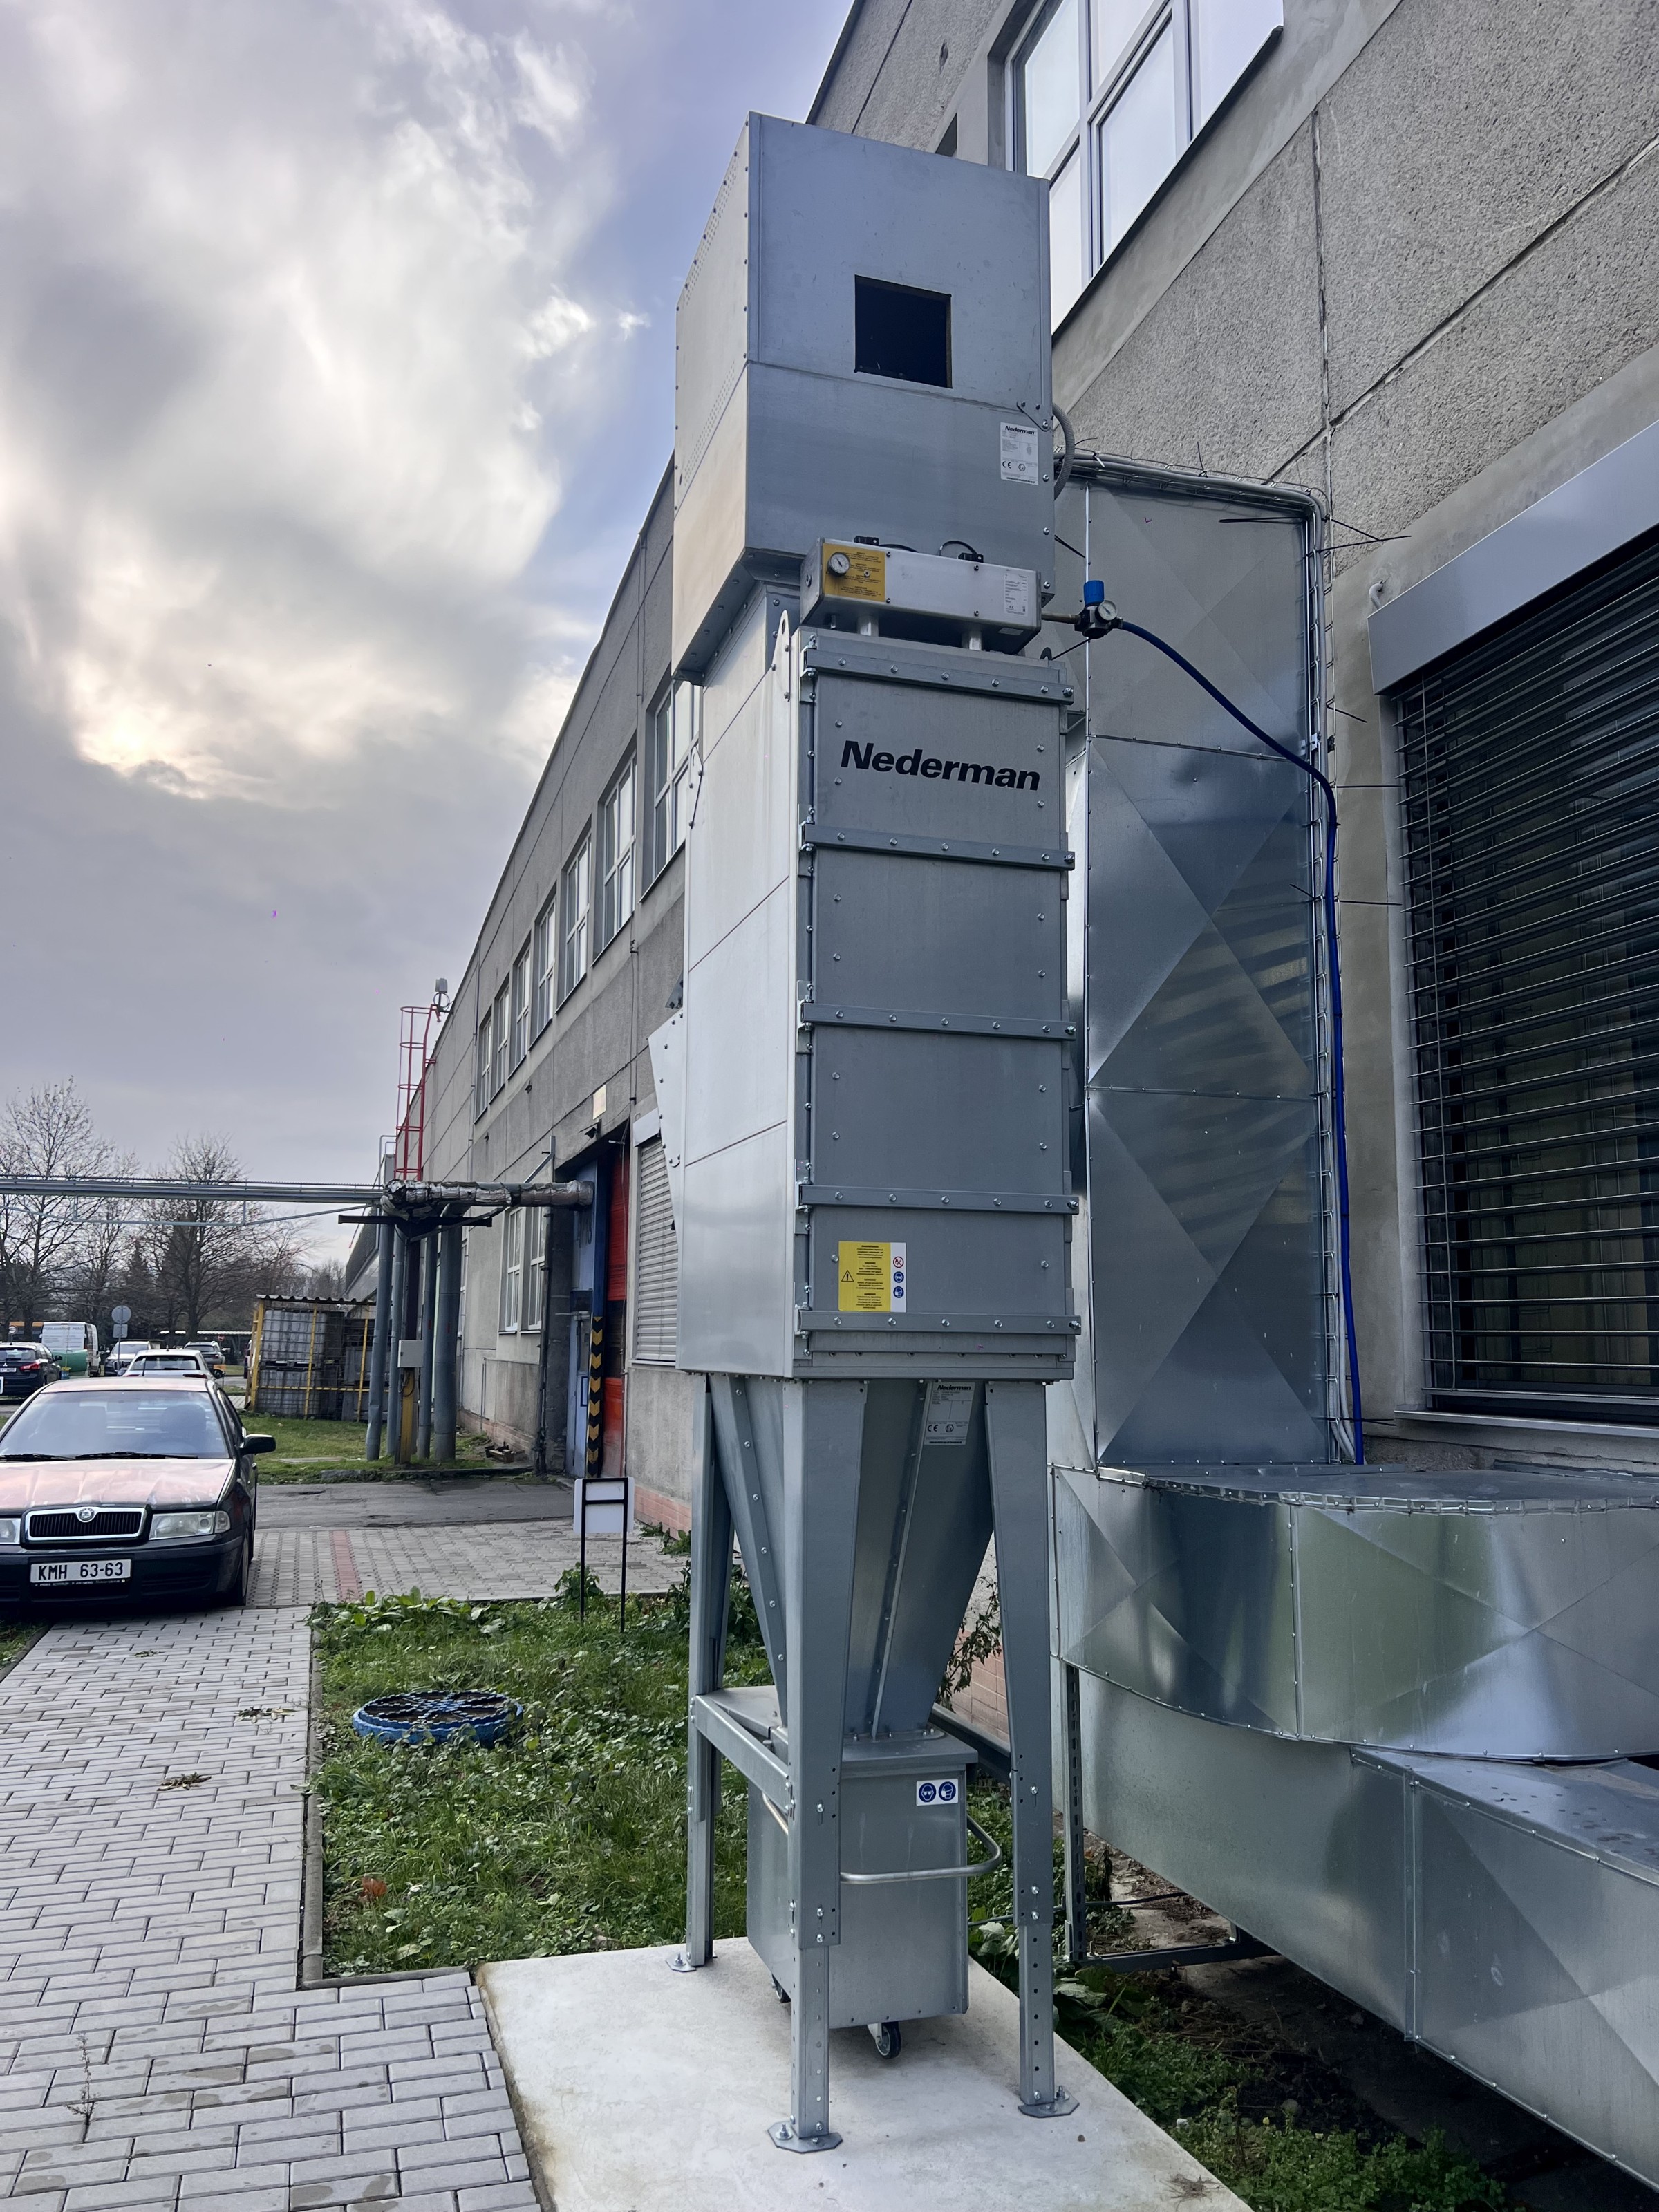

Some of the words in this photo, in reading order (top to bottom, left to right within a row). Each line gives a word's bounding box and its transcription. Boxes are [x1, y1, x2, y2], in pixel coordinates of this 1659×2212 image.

[1005, 425, 1035, 435] Nederman
[841, 740, 1040, 791] Nederman
[39, 1564, 68, 1580] KMH
[79, 1562, 124, 1577] 63-63
